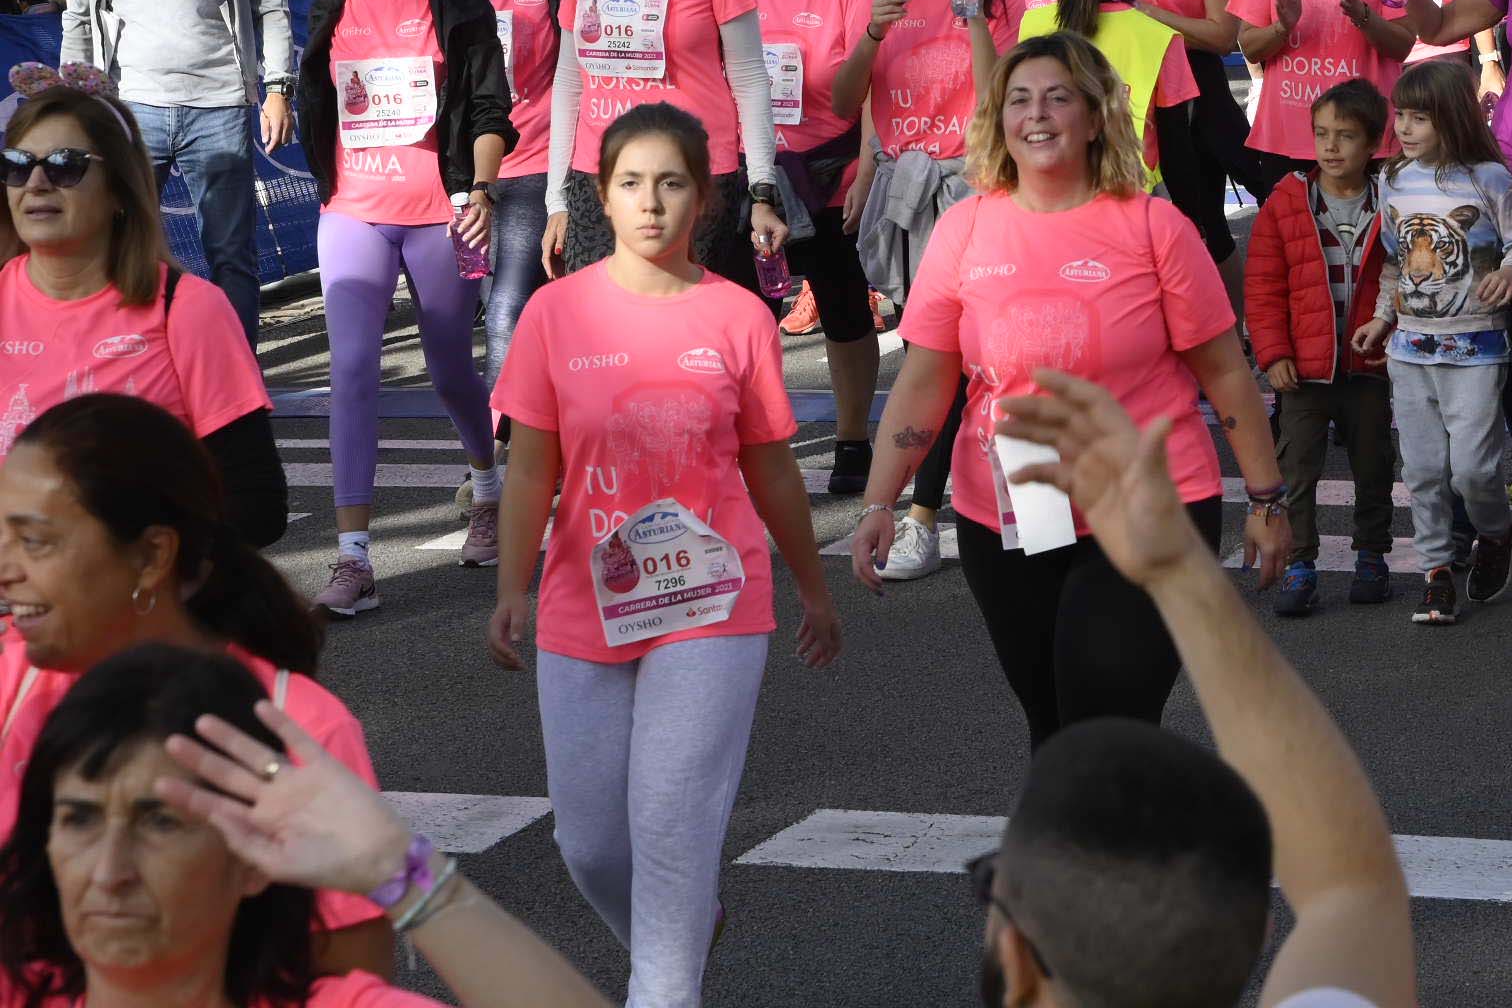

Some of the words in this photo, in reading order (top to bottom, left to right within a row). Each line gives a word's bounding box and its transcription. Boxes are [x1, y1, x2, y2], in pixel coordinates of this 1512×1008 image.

[604, 24, 634, 37] 016
[607, 41, 631, 49] 25242
[1282, 56, 1361, 77] DORSAL
[371, 93, 403, 106] 016
[890, 89, 912, 110] TU
[343, 150, 403, 174] SUMA
[568, 352, 629, 372] OYSHO
[585, 464, 619, 496] TU
[642, 549, 692, 576] 016
[655, 575, 686, 592] 7296
[618, 600, 657, 615] CARRERA
[658, 596, 670, 605] DE
[671, 593, 683, 603] LA
[683, 586, 712, 600] MUJER
[618, 616, 664, 635] OYSHO
